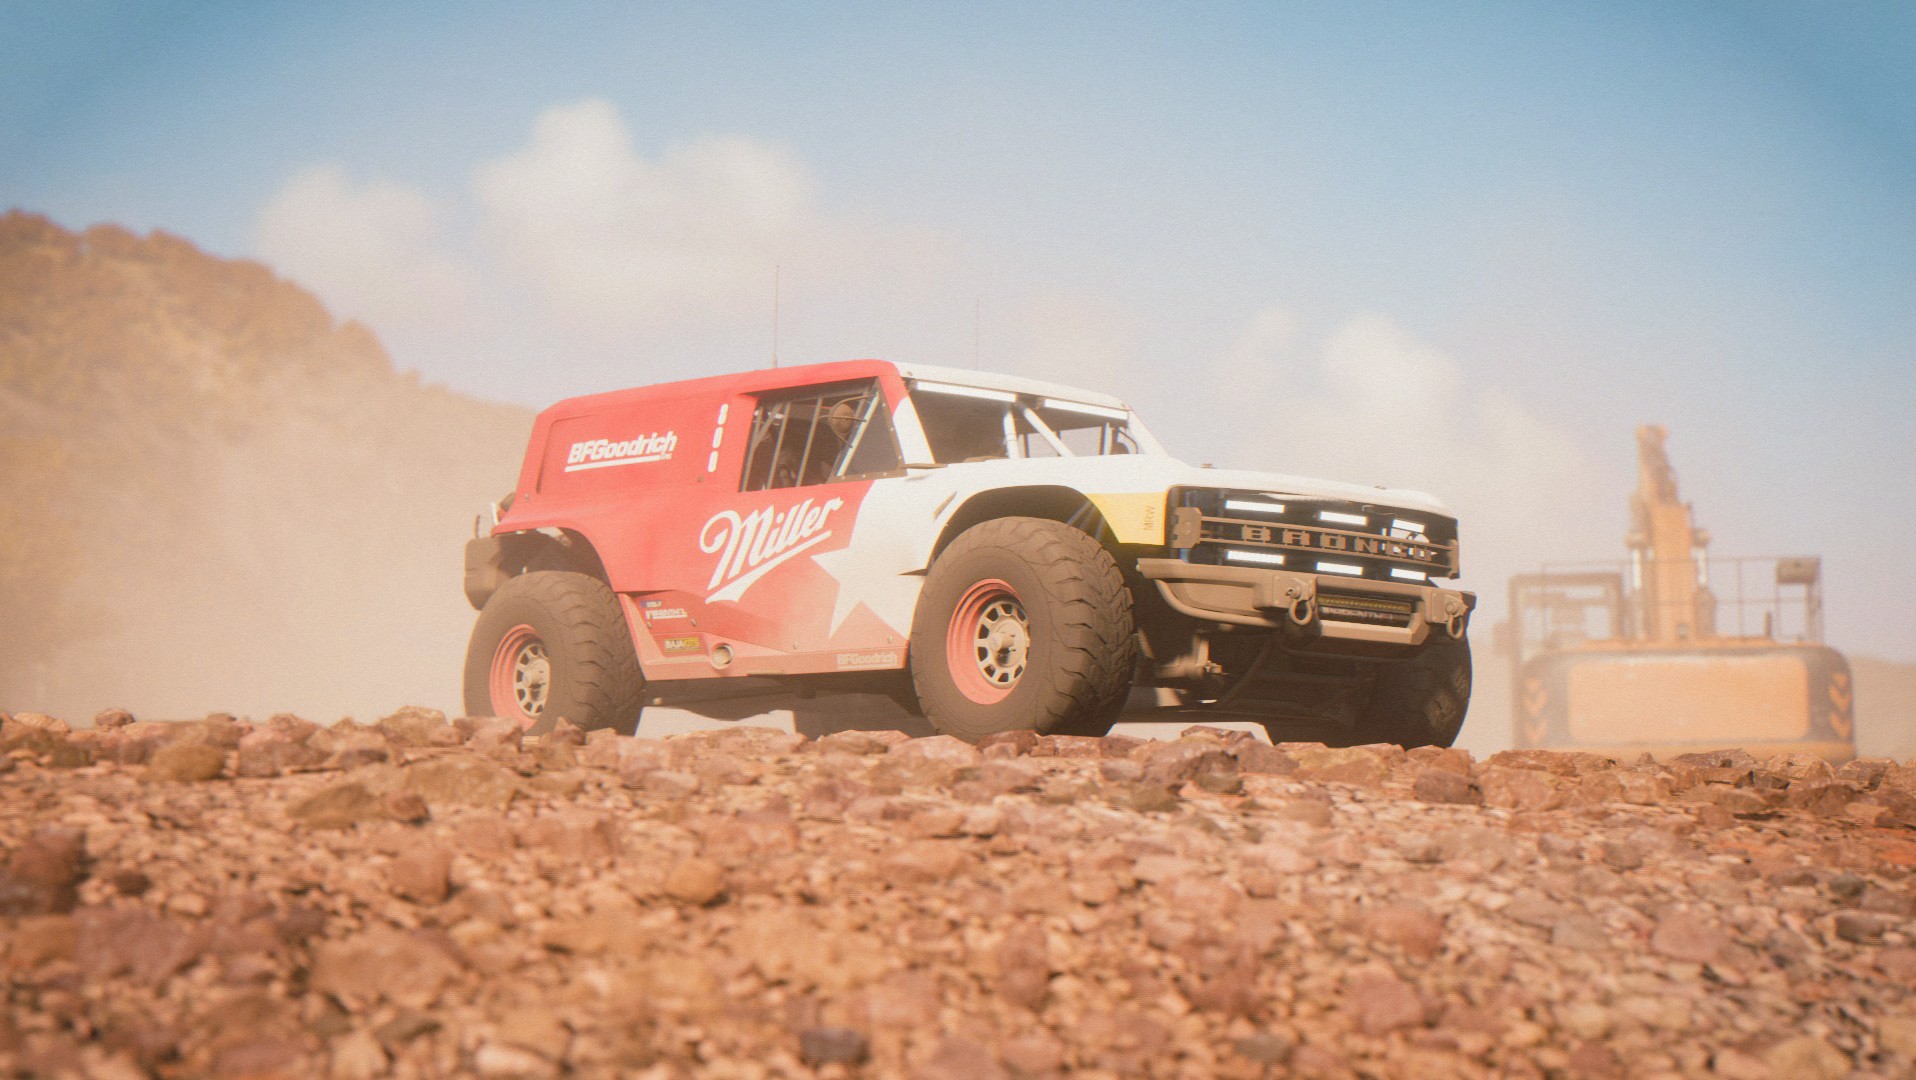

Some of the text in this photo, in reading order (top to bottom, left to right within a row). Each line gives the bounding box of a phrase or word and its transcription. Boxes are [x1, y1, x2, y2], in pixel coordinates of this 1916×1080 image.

[567, 430, 678, 464] BFGoodrich
[699, 496, 845, 591] Miller
[1241, 525, 1432, 562] BRONCO
[837, 650, 898, 665] BFGoodrich
